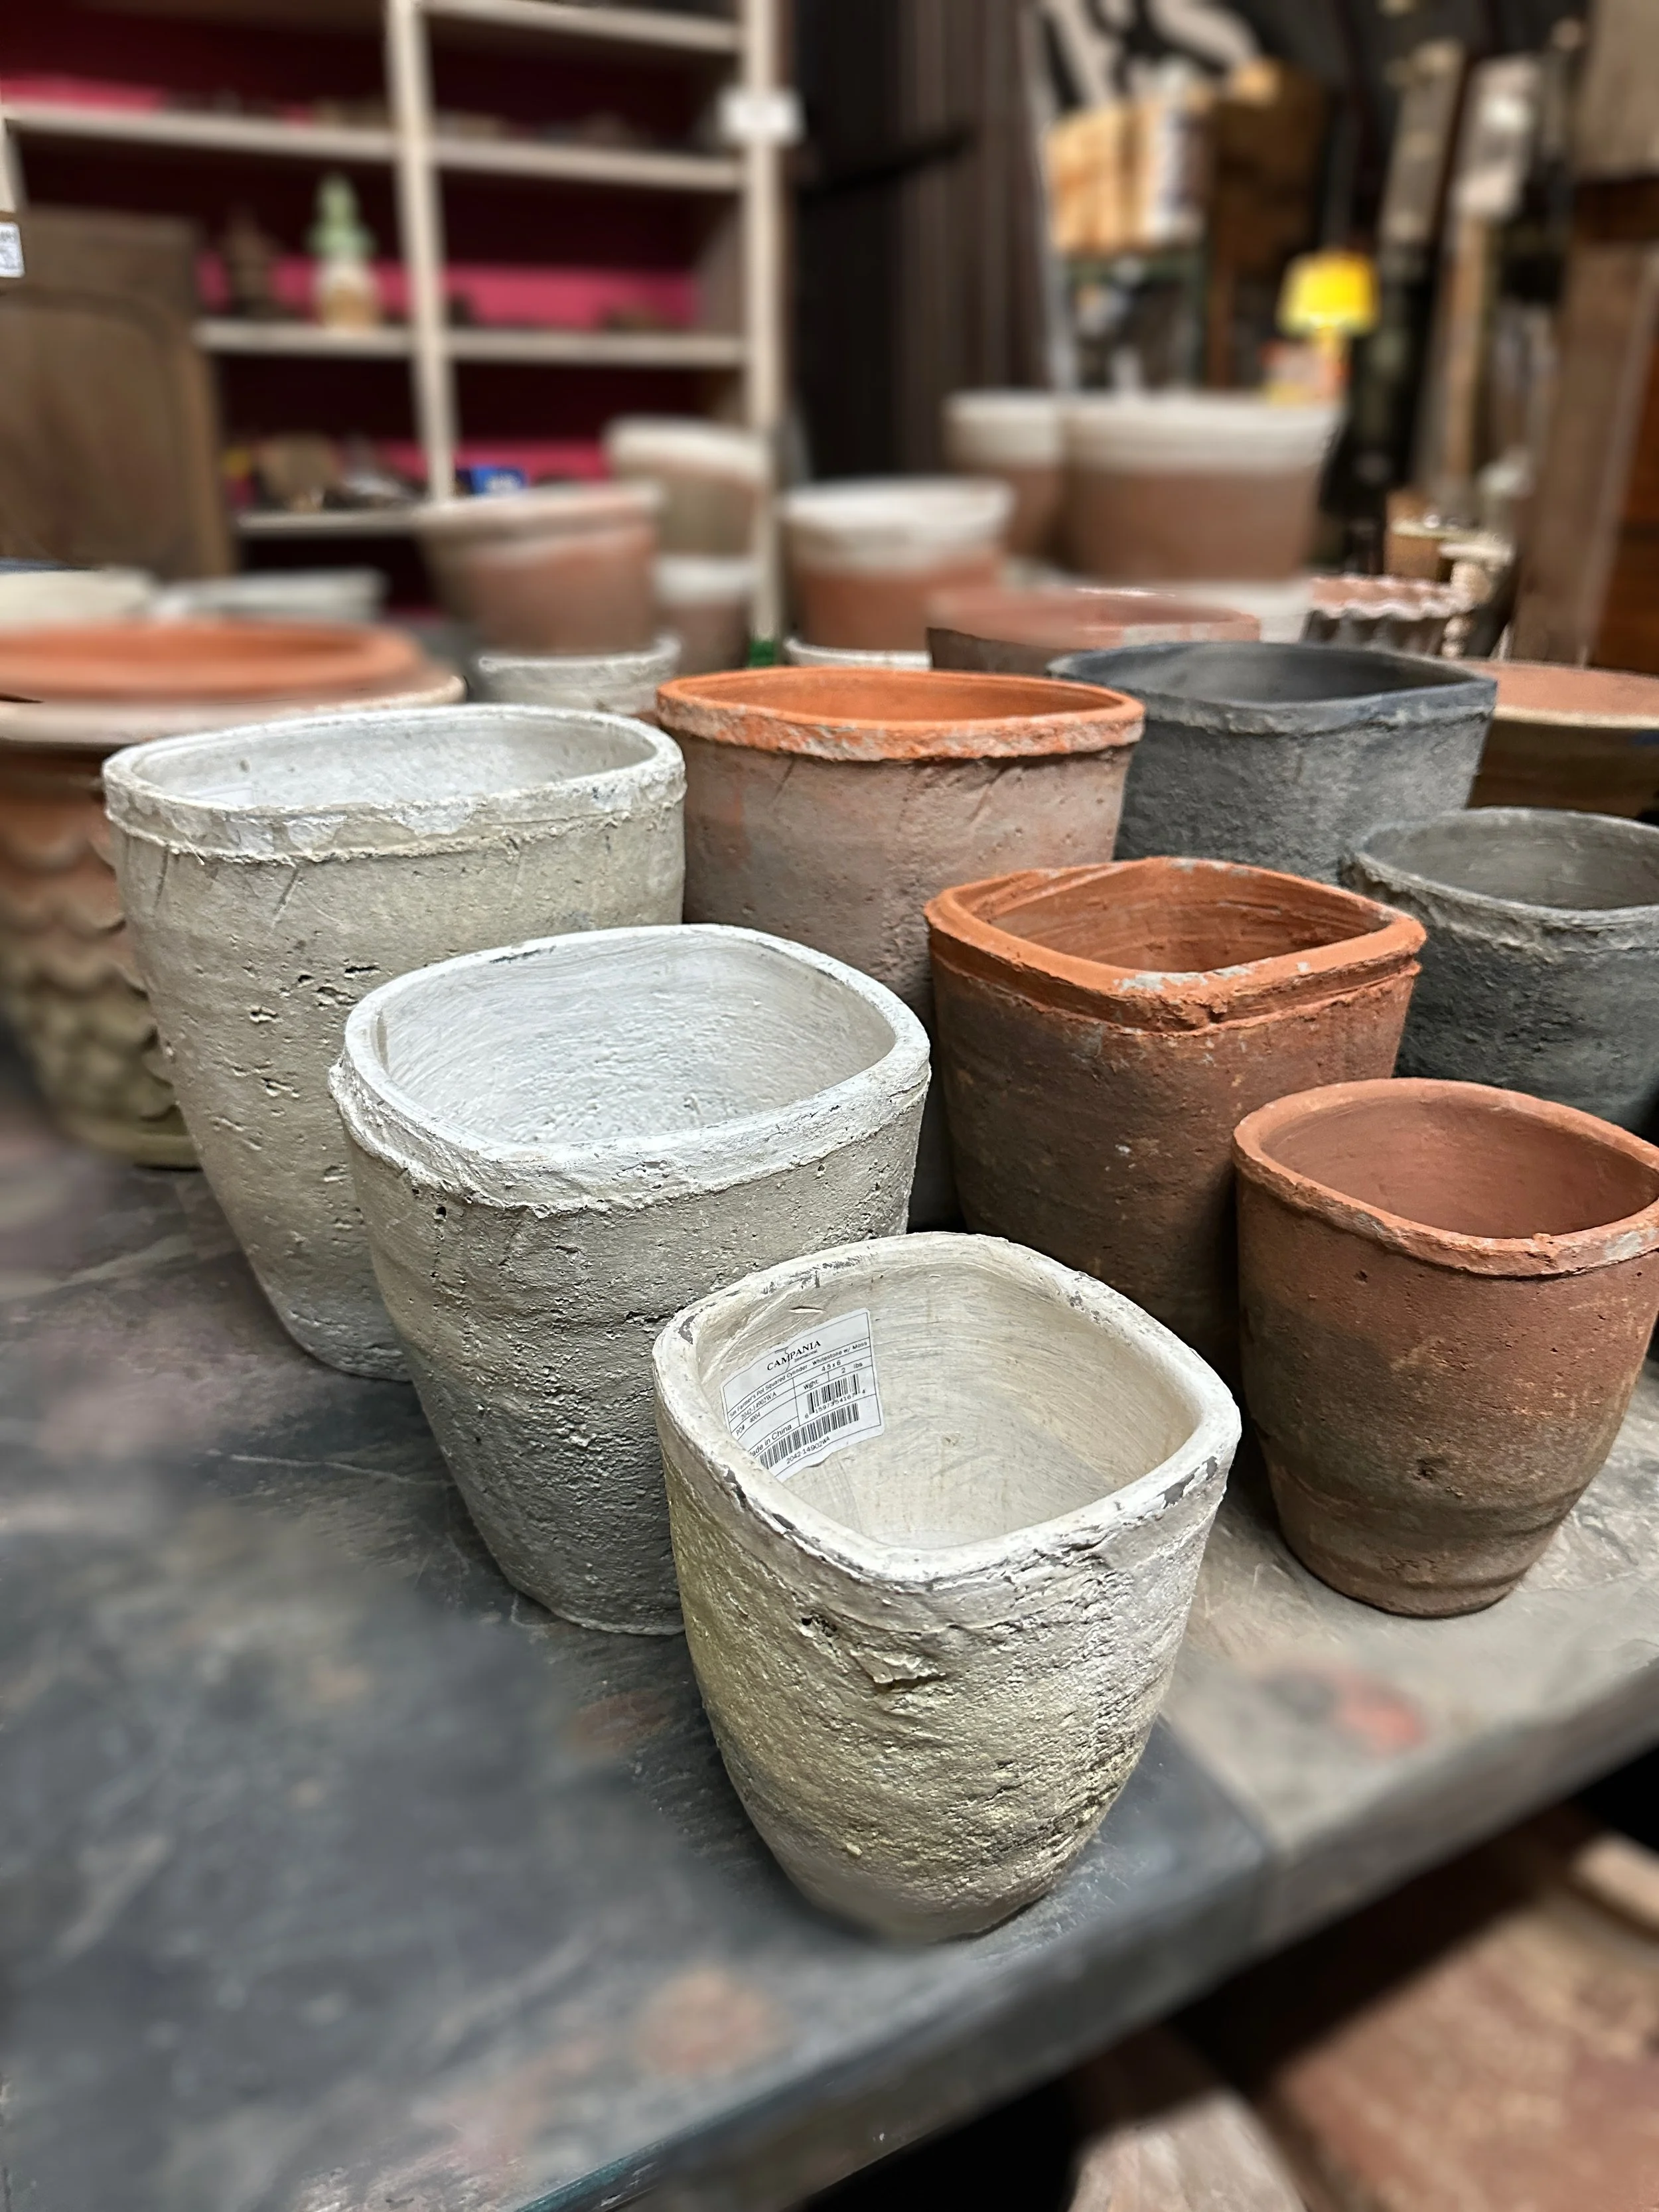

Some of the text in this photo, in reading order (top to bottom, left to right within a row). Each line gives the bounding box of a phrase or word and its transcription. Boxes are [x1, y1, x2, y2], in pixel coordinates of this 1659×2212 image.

[767, 1341, 821, 1370] CAMPANIA
[765, 1376, 785, 1390] Squared
[786, 1364, 808, 1378] Cylinder
[812, 1351, 842, 1365] Whitestone
[771, 1424, 792, 1440] China
